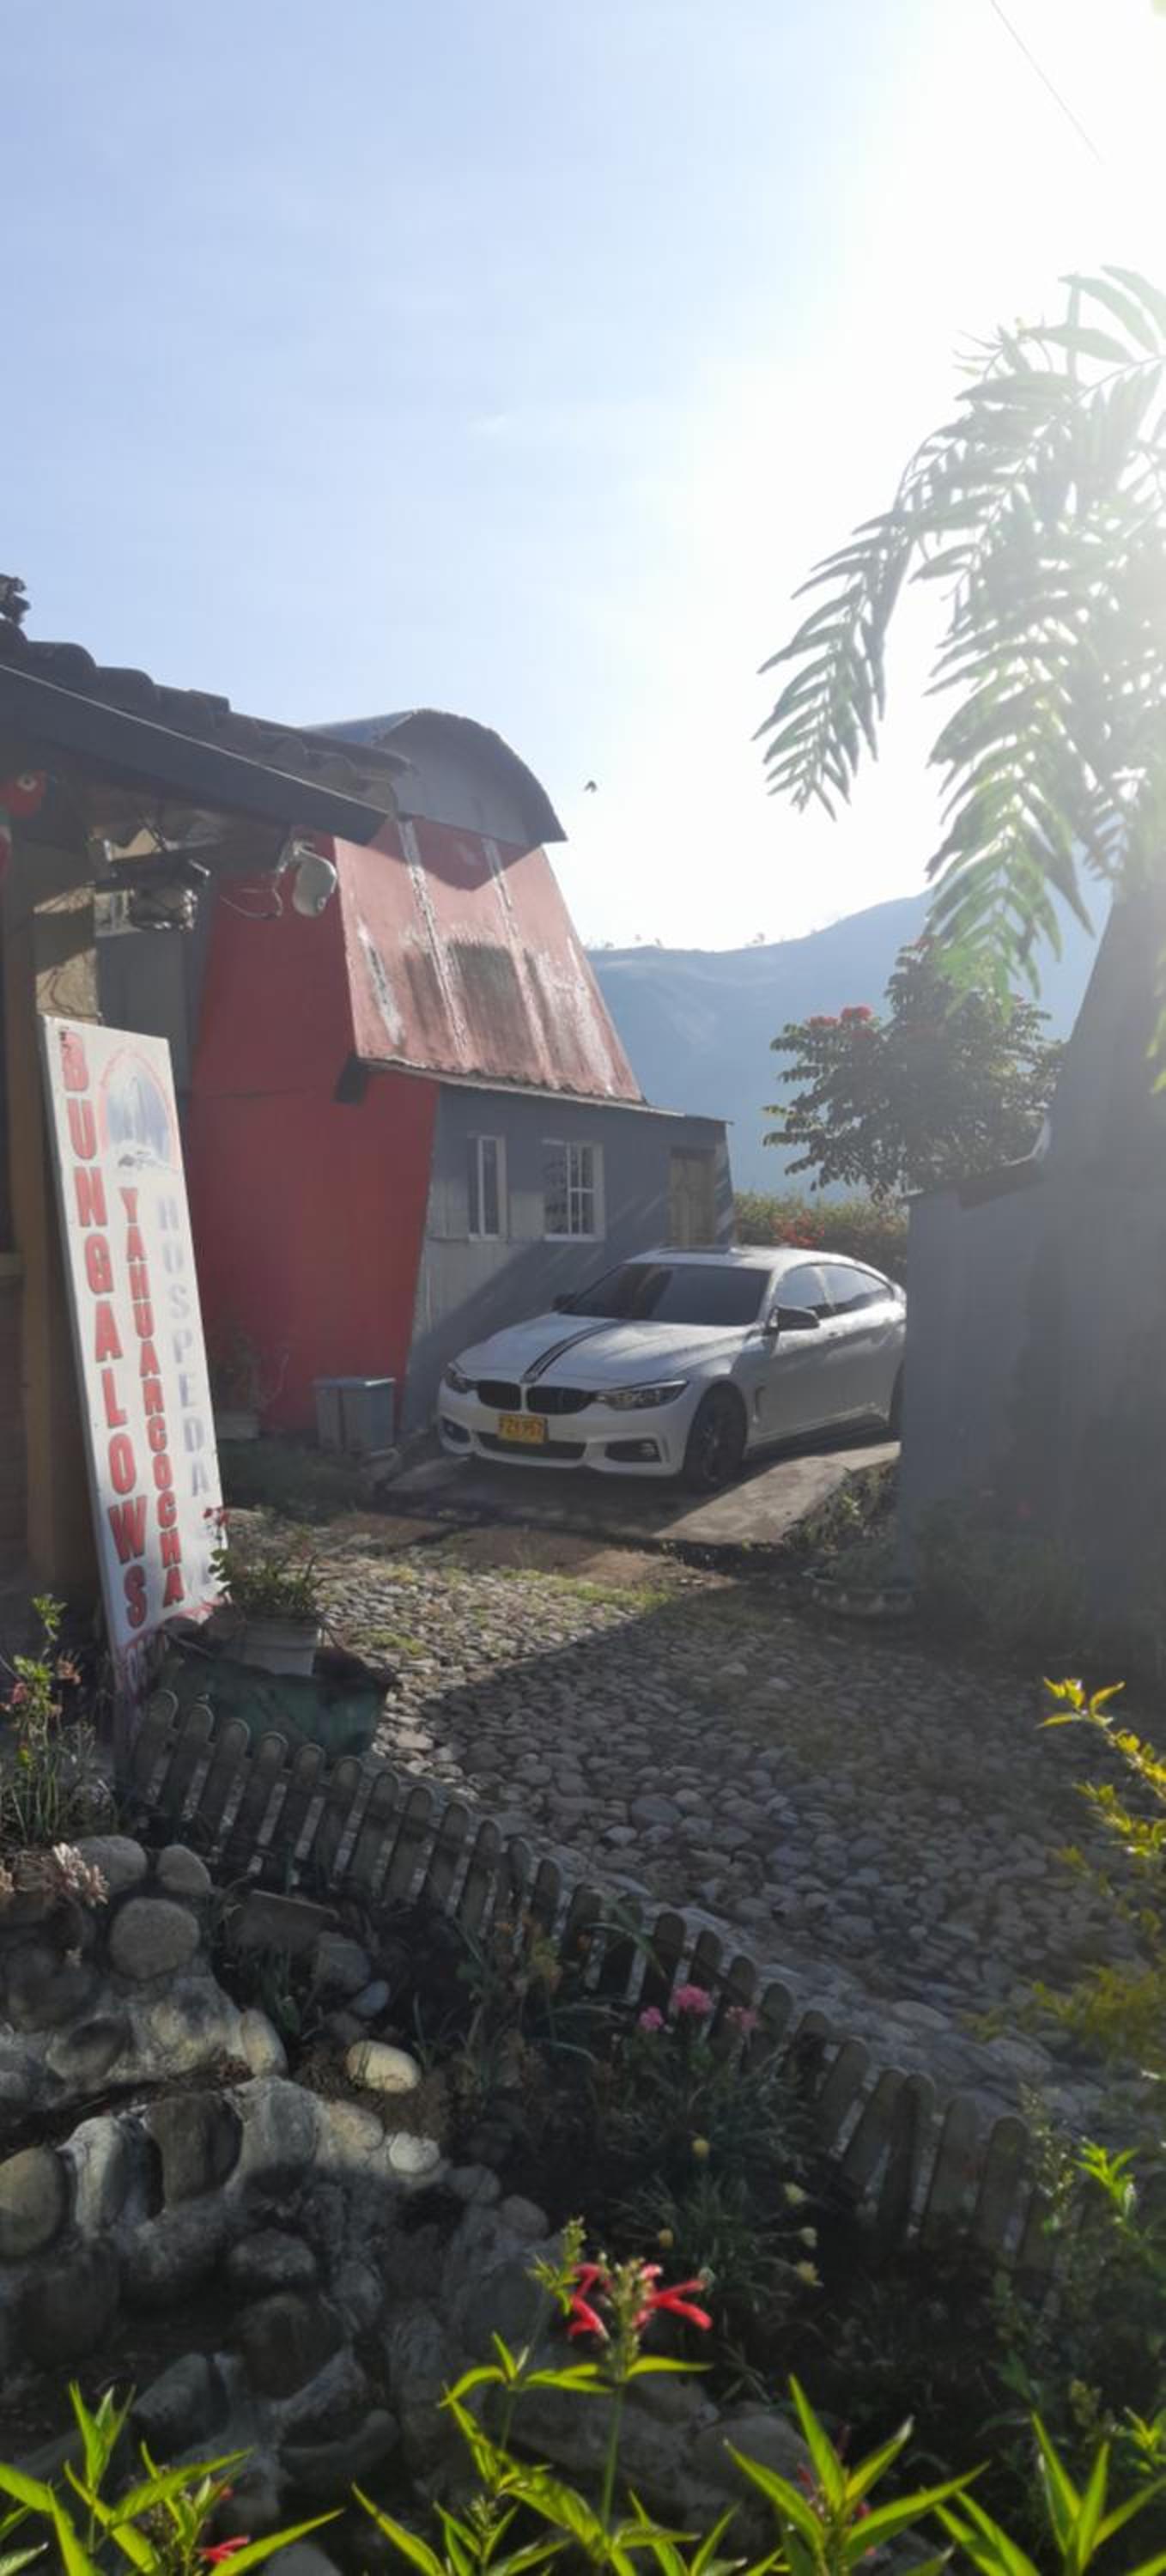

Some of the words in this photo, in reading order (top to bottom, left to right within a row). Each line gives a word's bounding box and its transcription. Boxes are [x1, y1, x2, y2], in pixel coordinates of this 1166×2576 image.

[60, 1029, 148, 1629] BUNGALOWS
[118, 1186, 185, 1608] YAHUARCOCHA
[158, 1196, 220, 1589] HOSPEDA
